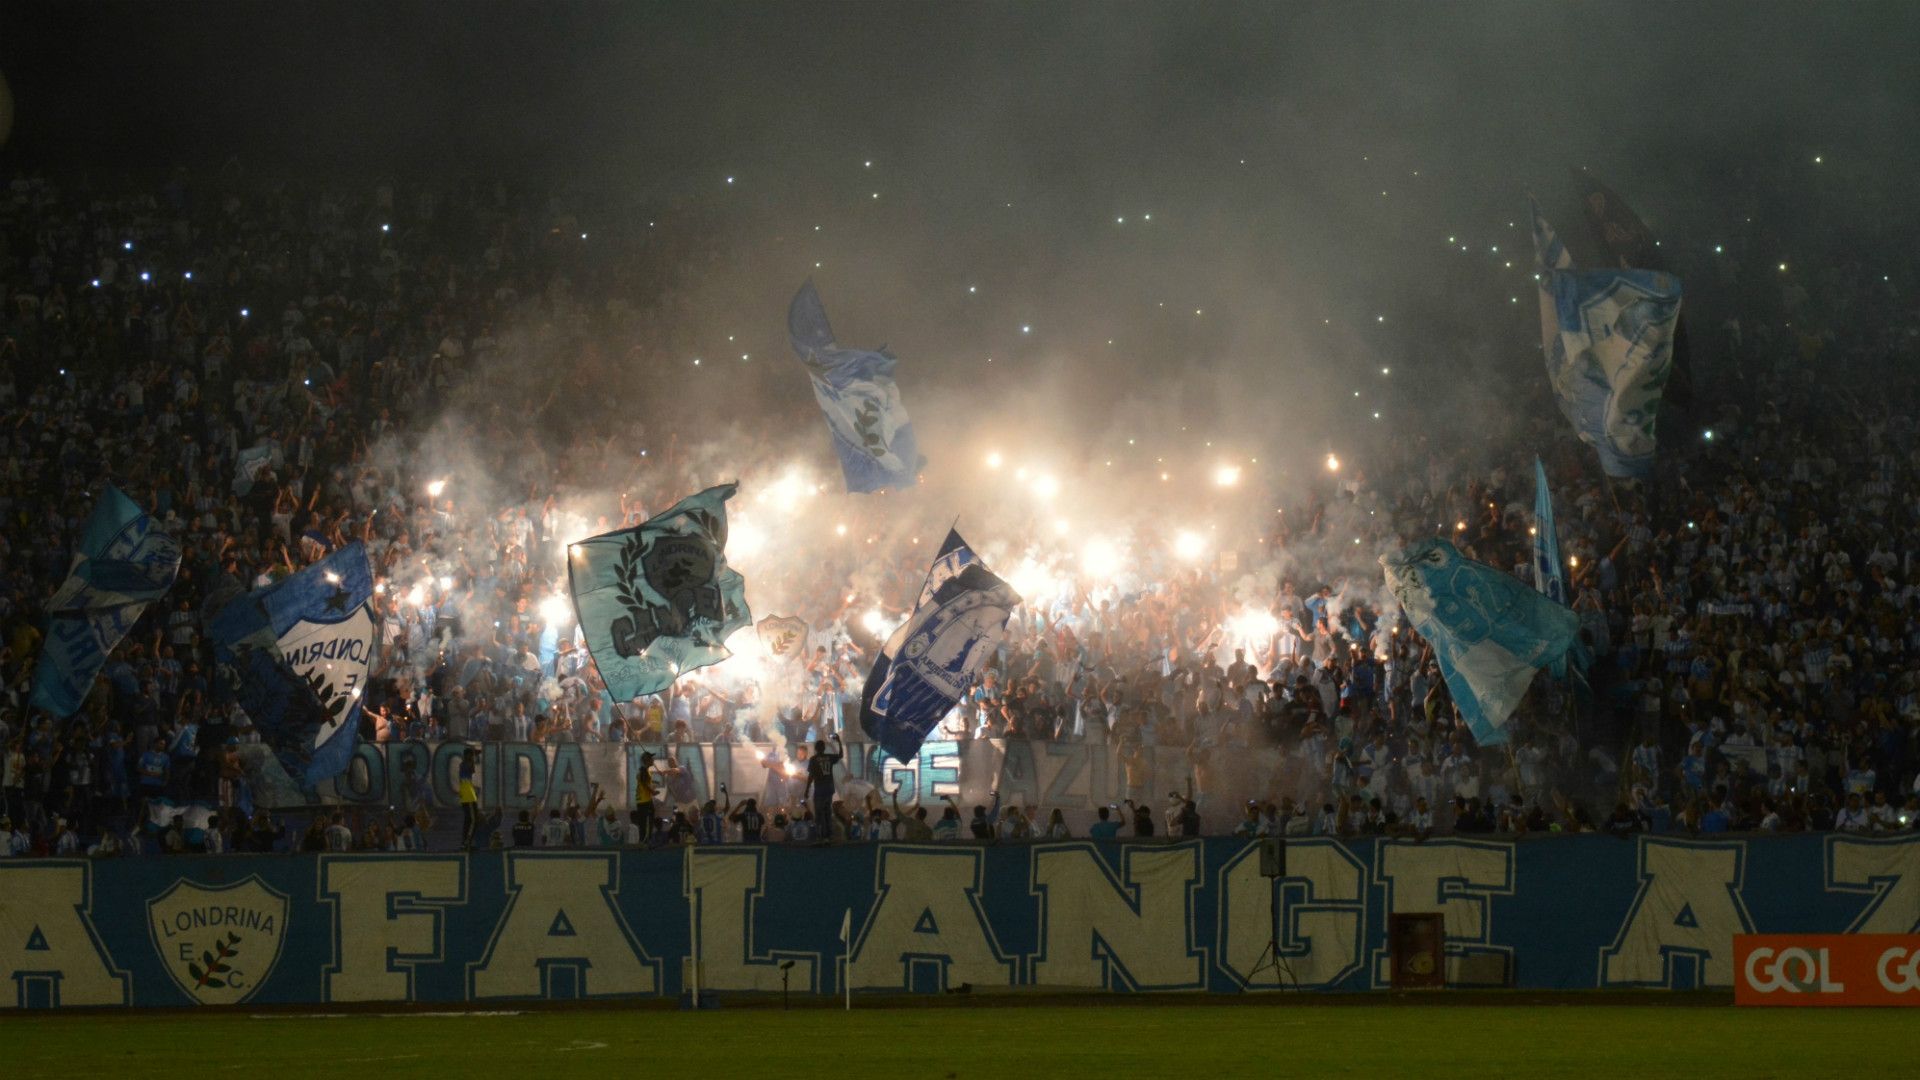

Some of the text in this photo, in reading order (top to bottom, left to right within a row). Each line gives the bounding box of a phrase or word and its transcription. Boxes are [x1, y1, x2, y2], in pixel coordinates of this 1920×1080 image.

[162, 906, 273, 937] LONDRINA
[317, 836, 1516, 1005] FALANGE
[1744, 946, 1845, 993] GOL
